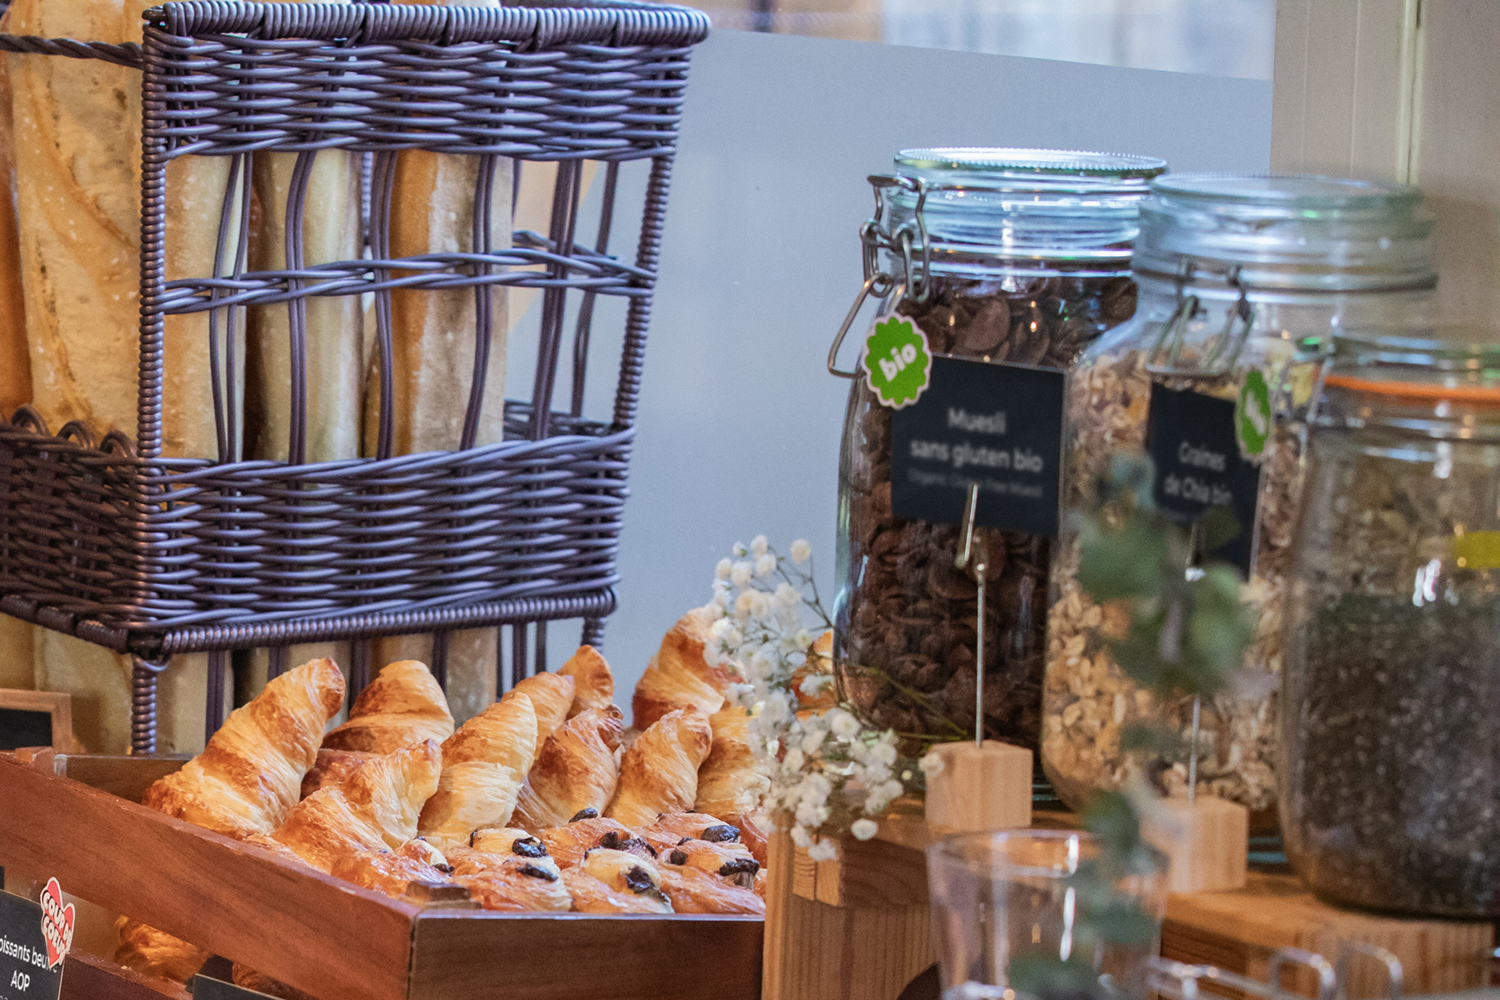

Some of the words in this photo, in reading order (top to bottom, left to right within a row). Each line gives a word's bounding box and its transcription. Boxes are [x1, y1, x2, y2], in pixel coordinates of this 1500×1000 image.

[878, 343, 917, 383] bio
[42, 889, 65, 930] COUP
[10, 970, 31, 992] AOP
